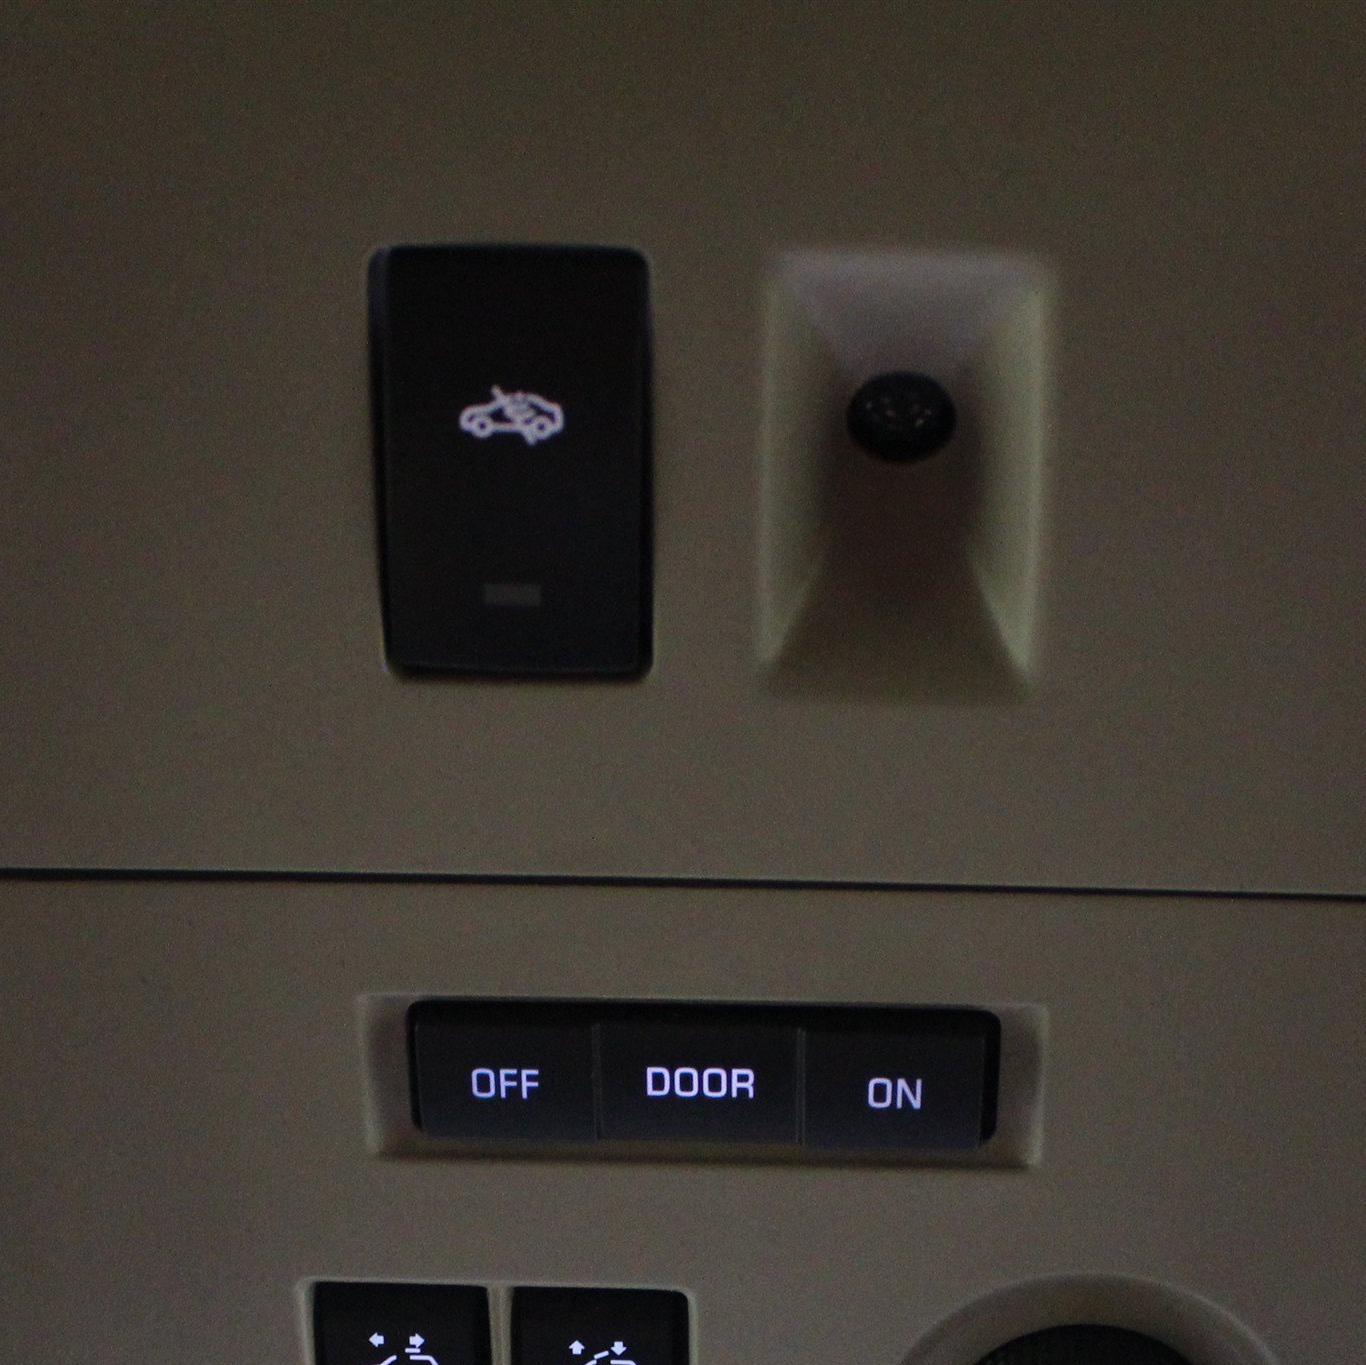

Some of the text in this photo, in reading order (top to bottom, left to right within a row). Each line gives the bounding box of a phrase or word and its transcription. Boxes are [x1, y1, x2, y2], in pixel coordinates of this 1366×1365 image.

[471, 1067, 539, 1100] OFF
[646, 1066, 755, 1099] DOOR
[867, 1077, 922, 1110] ON
